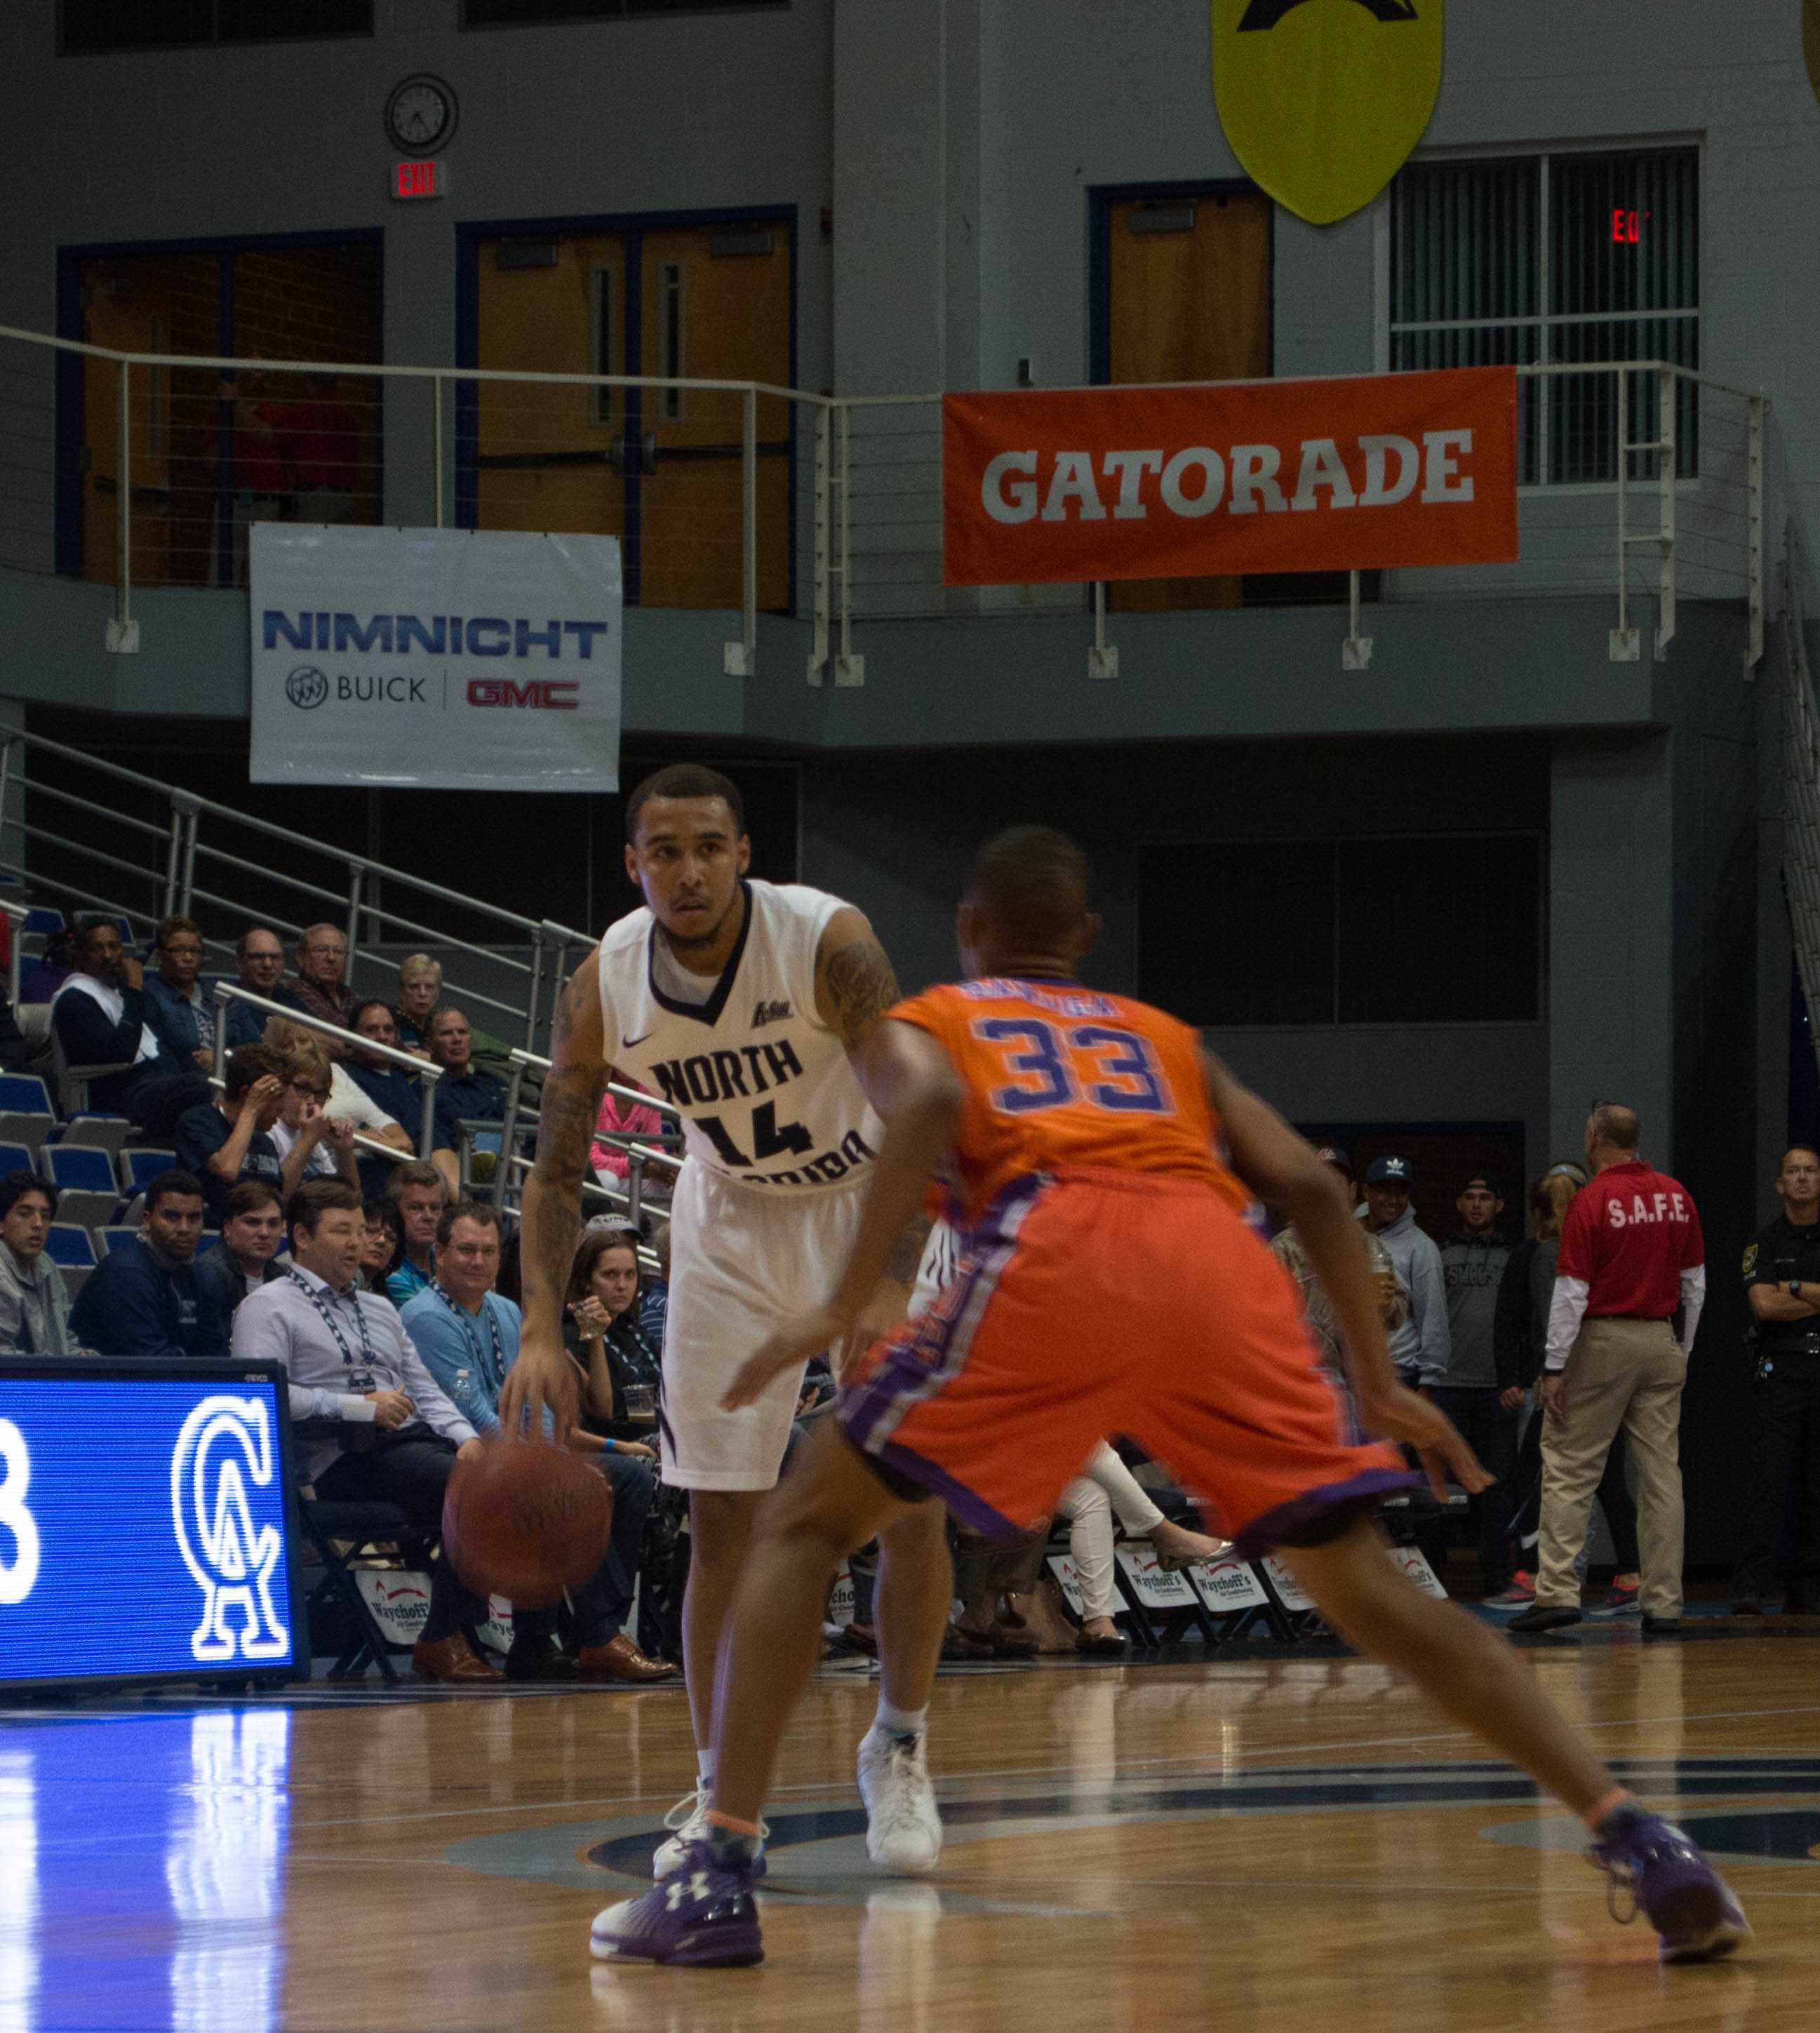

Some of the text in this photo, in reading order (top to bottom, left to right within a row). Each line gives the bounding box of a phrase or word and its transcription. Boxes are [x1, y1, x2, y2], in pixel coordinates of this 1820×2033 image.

[399, 161, 436, 196] EXIT
[981, 427, 1475, 524] GATORADE
[262, 610, 608, 659] NIMNICHT
[337, 676, 427, 702] BUICK
[467, 678, 580, 709] GMC
[648, 1039, 803, 1107] NORTH
[969, 1016, 1179, 1115] 33
[692, 1099, 814, 1167] 14
[1607, 1193, 1690, 1228] S.A.F.E.
[1197, 1574, 1251, 1593] Waychoff's
